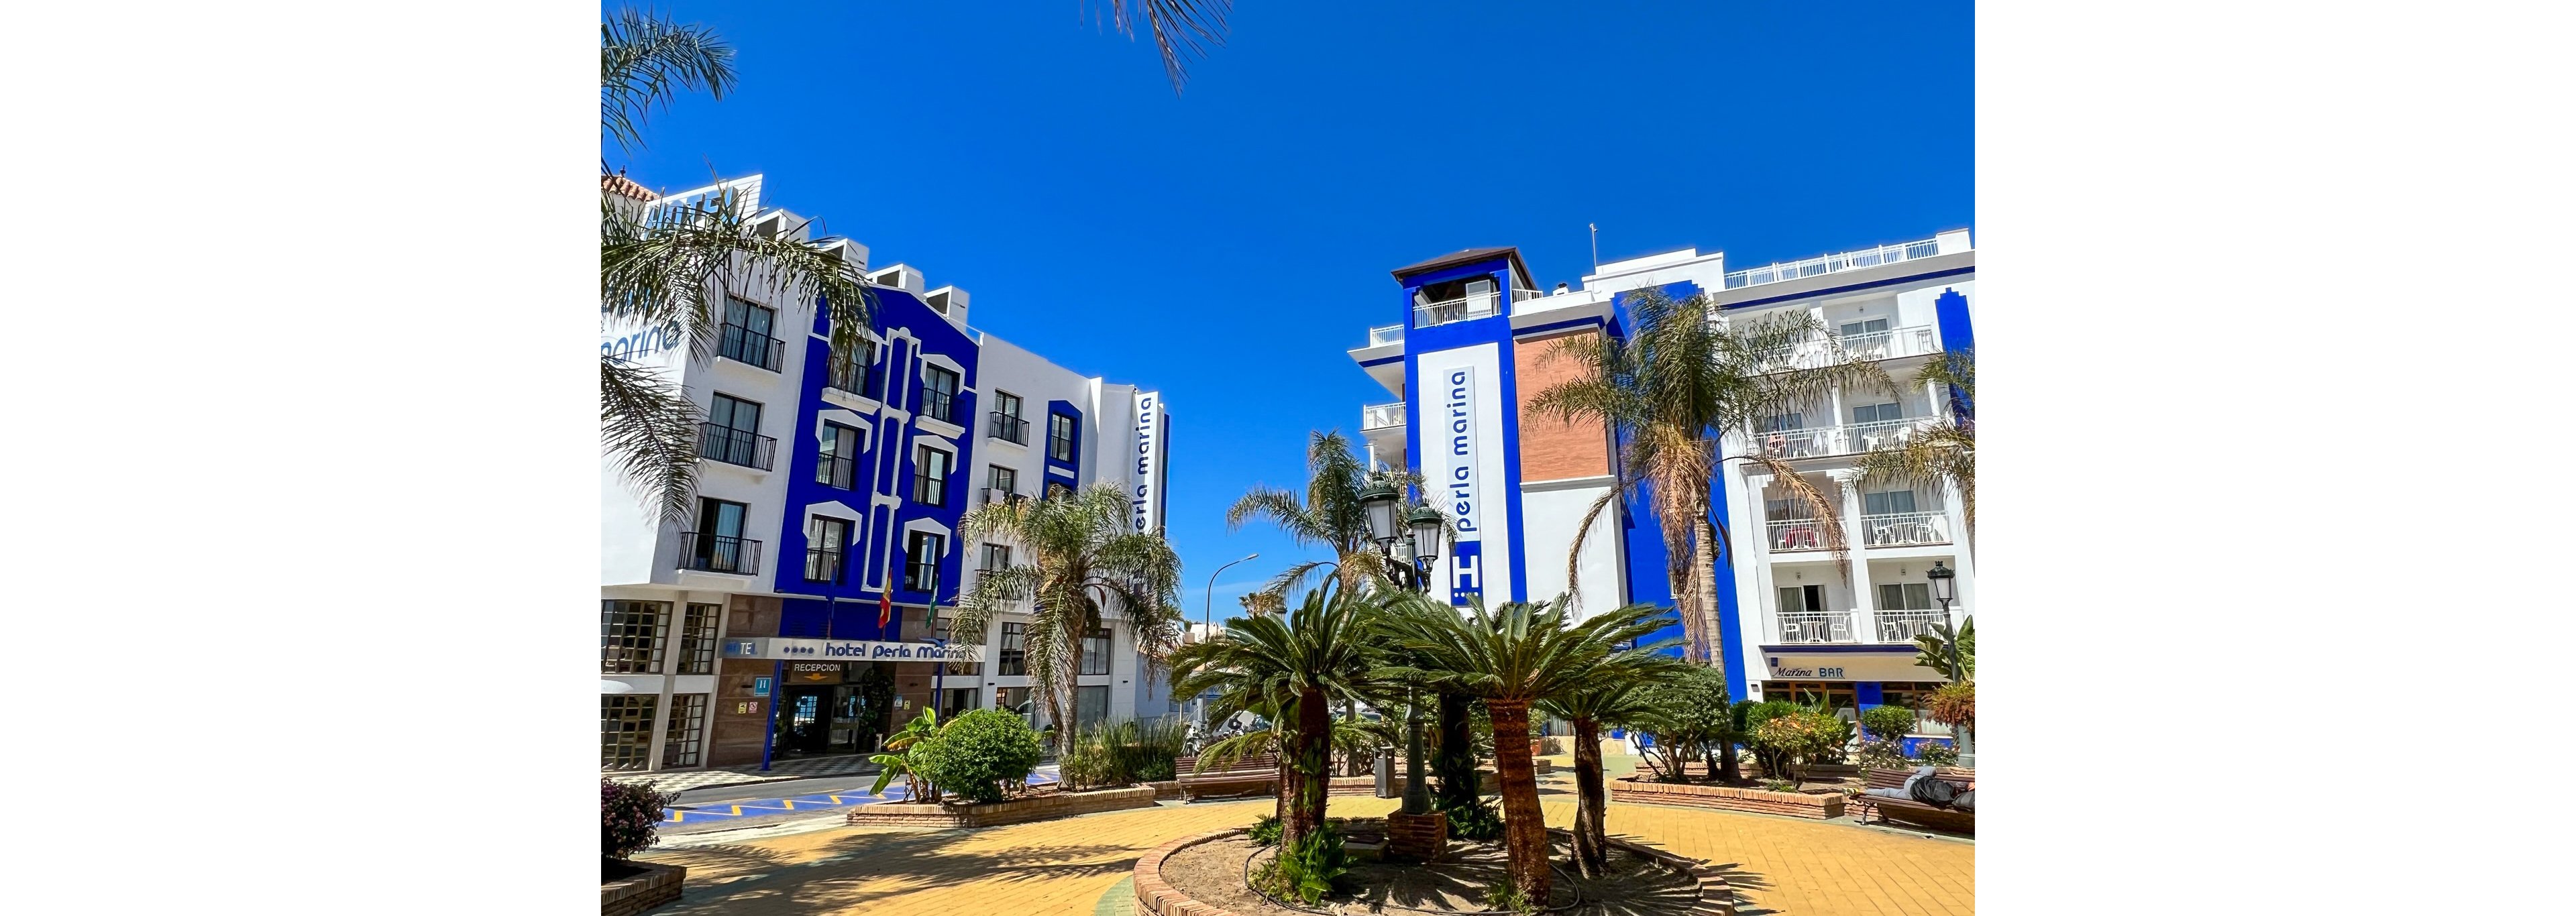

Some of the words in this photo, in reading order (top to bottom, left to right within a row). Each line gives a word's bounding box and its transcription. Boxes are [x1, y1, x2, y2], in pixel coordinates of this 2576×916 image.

[1135, 398, 1151, 475] marina
[1447, 371, 1468, 456] marina
[1132, 484, 1148, 536] erla
[1450, 466, 1478, 532] perla
[1452, 555, 1479, 589] H
[825, 642, 867, 656] hotel
[1772, 667, 1813, 677] Marina
[1819, 668, 1843, 677] BAR
